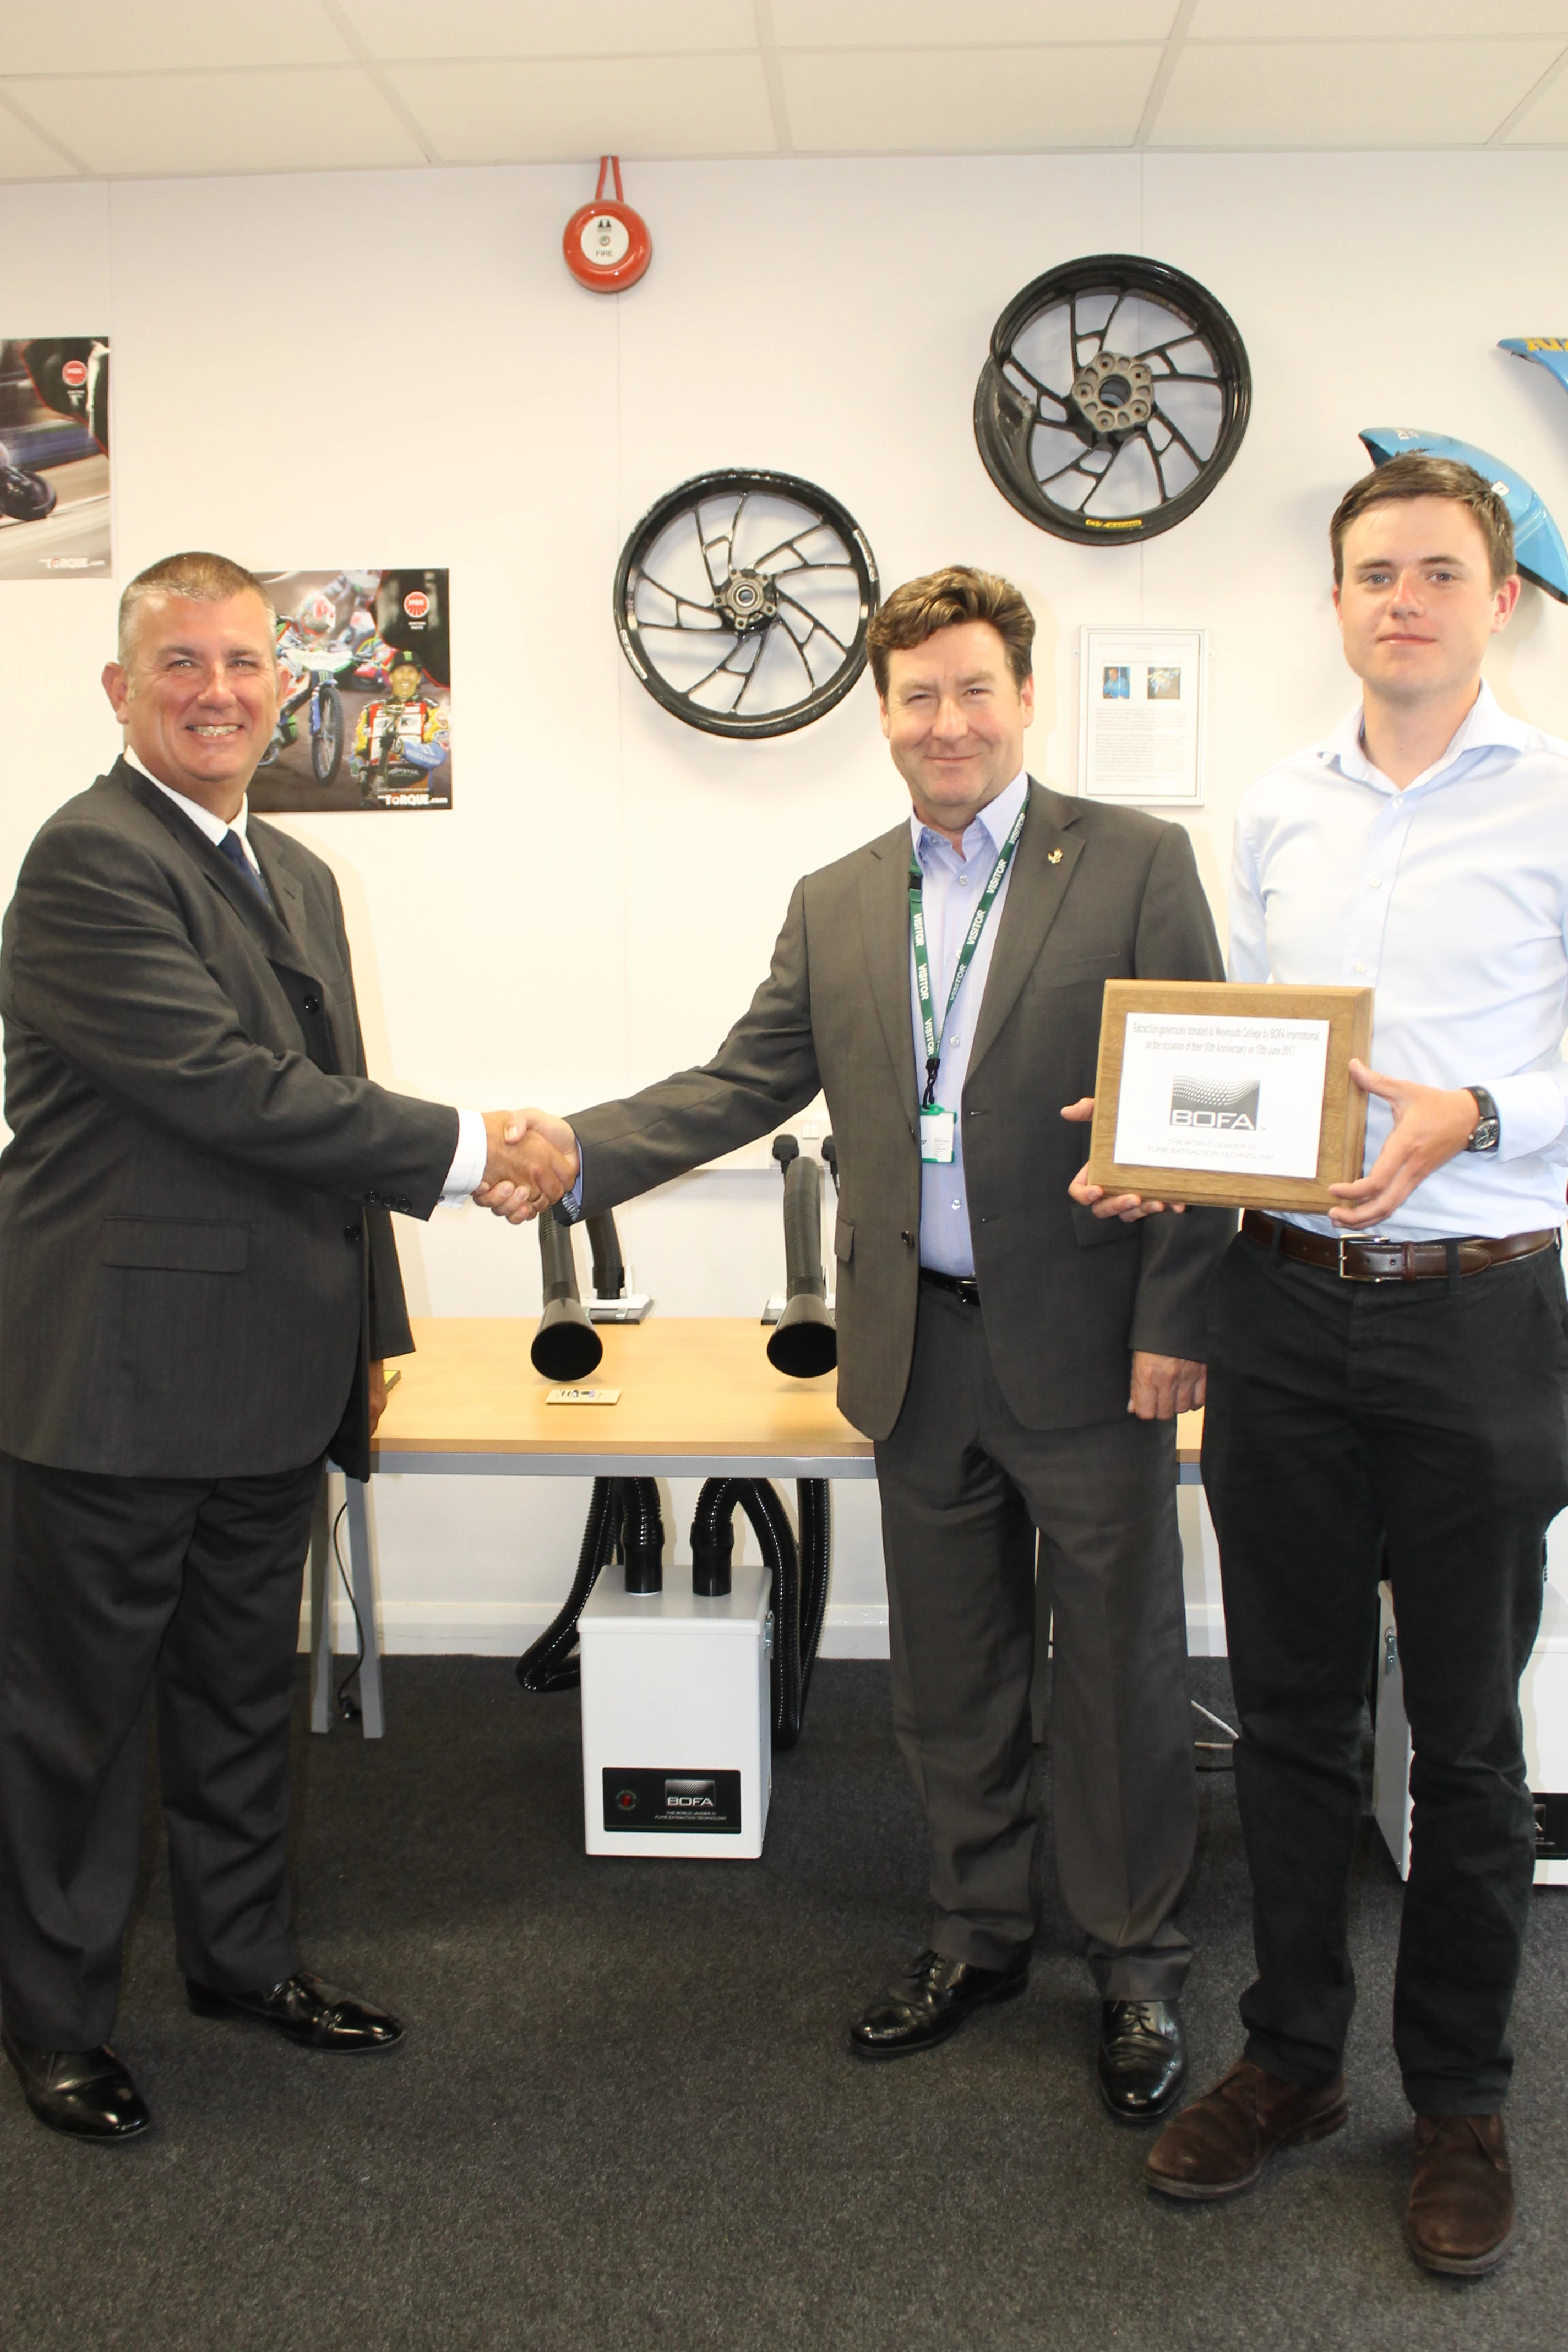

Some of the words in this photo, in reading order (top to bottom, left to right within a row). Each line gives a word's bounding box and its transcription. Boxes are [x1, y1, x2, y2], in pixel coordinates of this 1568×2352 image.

[986, 858, 1007, 894] VISITOR
[913, 912, 924, 947] VISITOR
[966, 909, 986, 945] VISITOR
[918, 963, 929, 1001] VISITOR
[950, 964, 967, 1001] VISITOR
[924, 1017, 935, 1056] VISITOR
[1133, 1022, 1158, 1033] Extraction
[1159, 1025, 1186, 1038] generously
[1188, 1025, 1208, 1036] donated
[1209, 1026, 1215, 1036] to
[1215, 1027, 1242, 1039] Weymouth
[1243, 1027, 1262, 1041] College
[1262, 1028, 1269, 1041] by
[1270, 1028, 1285, 1039] BOFA
[1286, 1030, 1320, 1041] International
[1162, 1041, 1184, 1050] occasion
[1185, 1041, 1191, 1051] of
[1191, 1041, 1204, 1052] their
[1204, 1042, 1215, 1052] 30th
[1216, 1042, 1247, 1056] Anniversary
[1256, 1044, 1267, 1055] 12th
[1267, 1045, 1281, 1055] June
[1171, 1109, 1255, 1130] BOFA
[1147, 1146, 1169, 1154] FUME
[1170, 1147, 1219, 1157] EXTRACTION
[1220, 1151, 1276, 1161] TECHNOLOGY
[1184, 1140, 1213, 1148] WORLD
[1215, 1142, 1246, 1150] LEADER
[667, 1796, 714, 1806] BOFA
